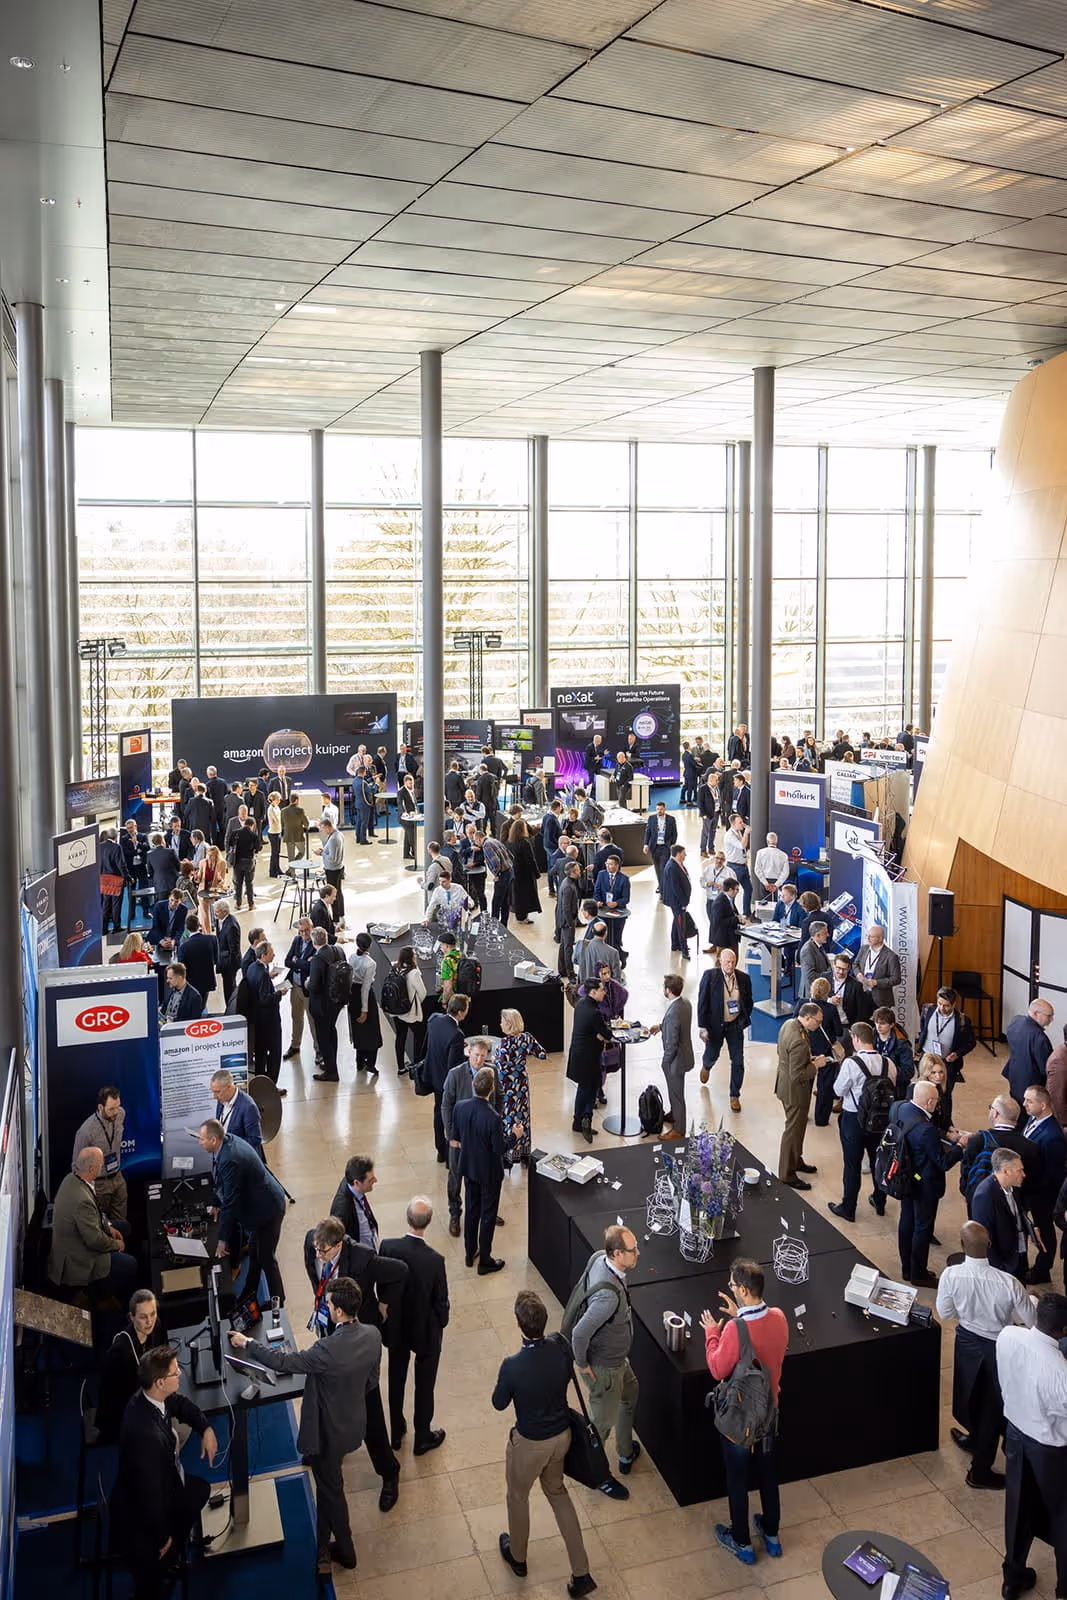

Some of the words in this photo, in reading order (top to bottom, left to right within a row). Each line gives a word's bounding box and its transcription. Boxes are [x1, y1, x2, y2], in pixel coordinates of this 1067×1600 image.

[223, 749, 264, 761] amazon
[272, 746, 313, 759] project
[315, 744, 351, 757] kuiper
[786, 790, 816, 801] holkirk
[68, 849, 88, 860] AVANTI
[81, 1010, 125, 1028] GRC
[190, 1023, 219, 1036] GRC
[163, 1047, 190, 1055] amazon
[194, 1042, 221, 1052] project
[222, 1039, 246, 1047] kuiper
